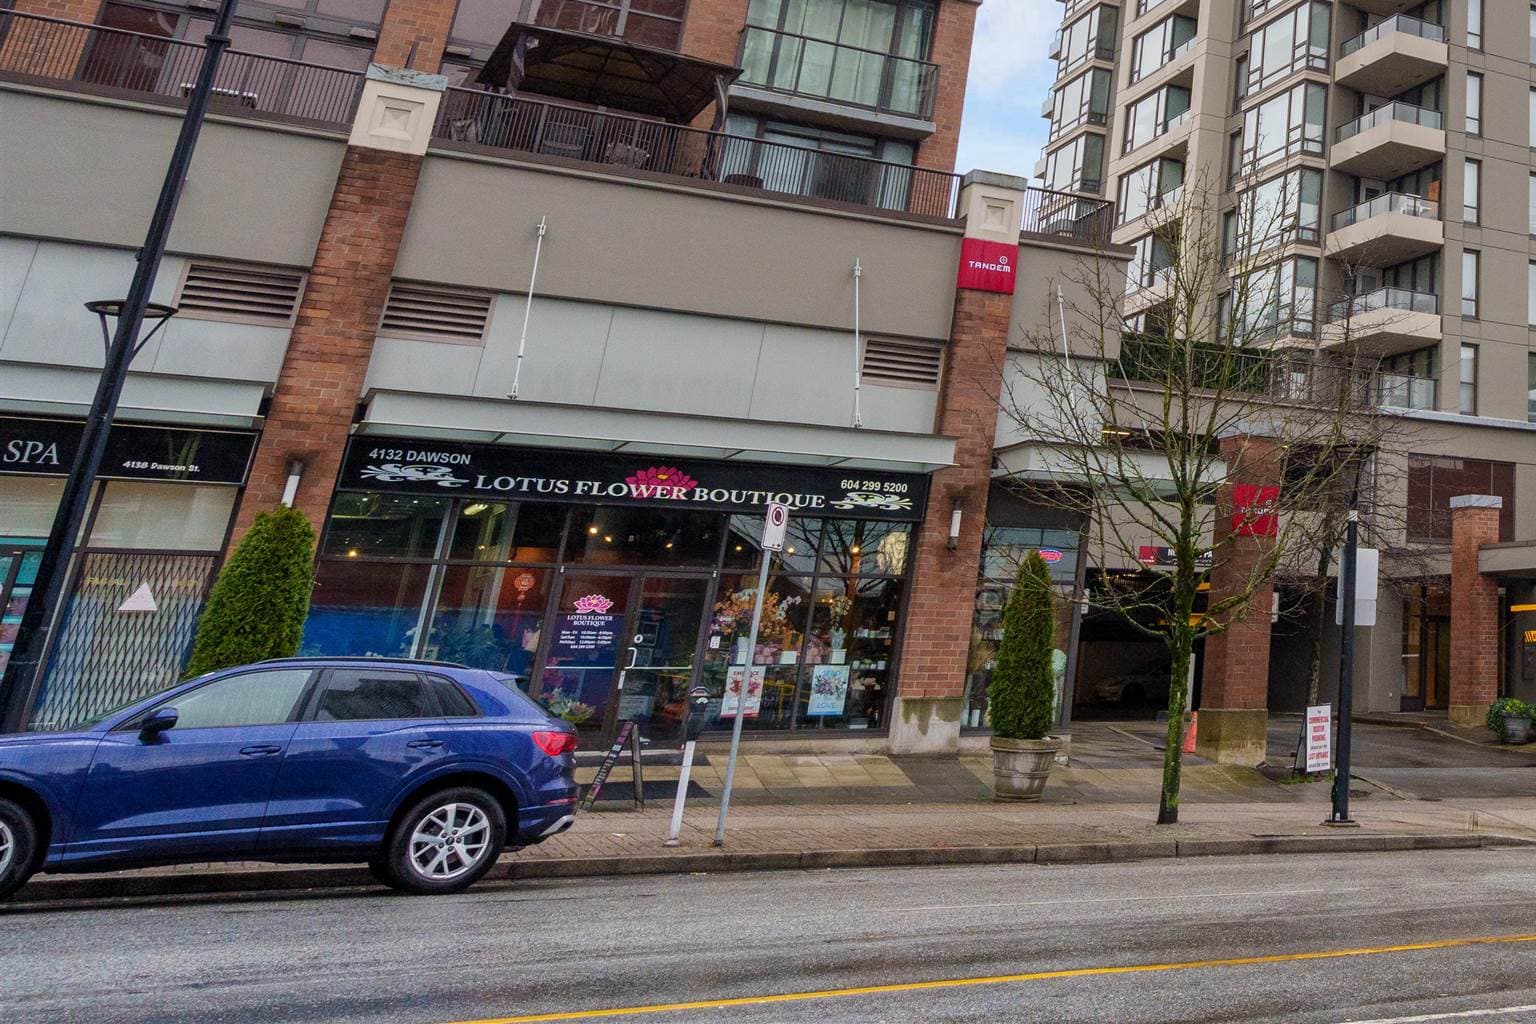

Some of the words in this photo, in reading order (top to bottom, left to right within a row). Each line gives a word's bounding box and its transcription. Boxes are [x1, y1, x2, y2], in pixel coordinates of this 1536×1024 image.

[968, 261, 1011, 273] TANDEM
[3, 439, 60, 465] SPA
[369, 448, 402, 461] 4132
[406, 450, 471, 465] DAWSON
[150, 462, 186, 472] Dawson
[188, 464, 201, 472] St.
[473, 475, 570, 494] LOTUS
[573, 481, 688, 500] FLOWER
[692, 488, 826, 509] BOUTIQUE
[841, 479, 860, 490] 604
[862, 480, 881, 491] 299
[883, 481, 908, 493] 5200
